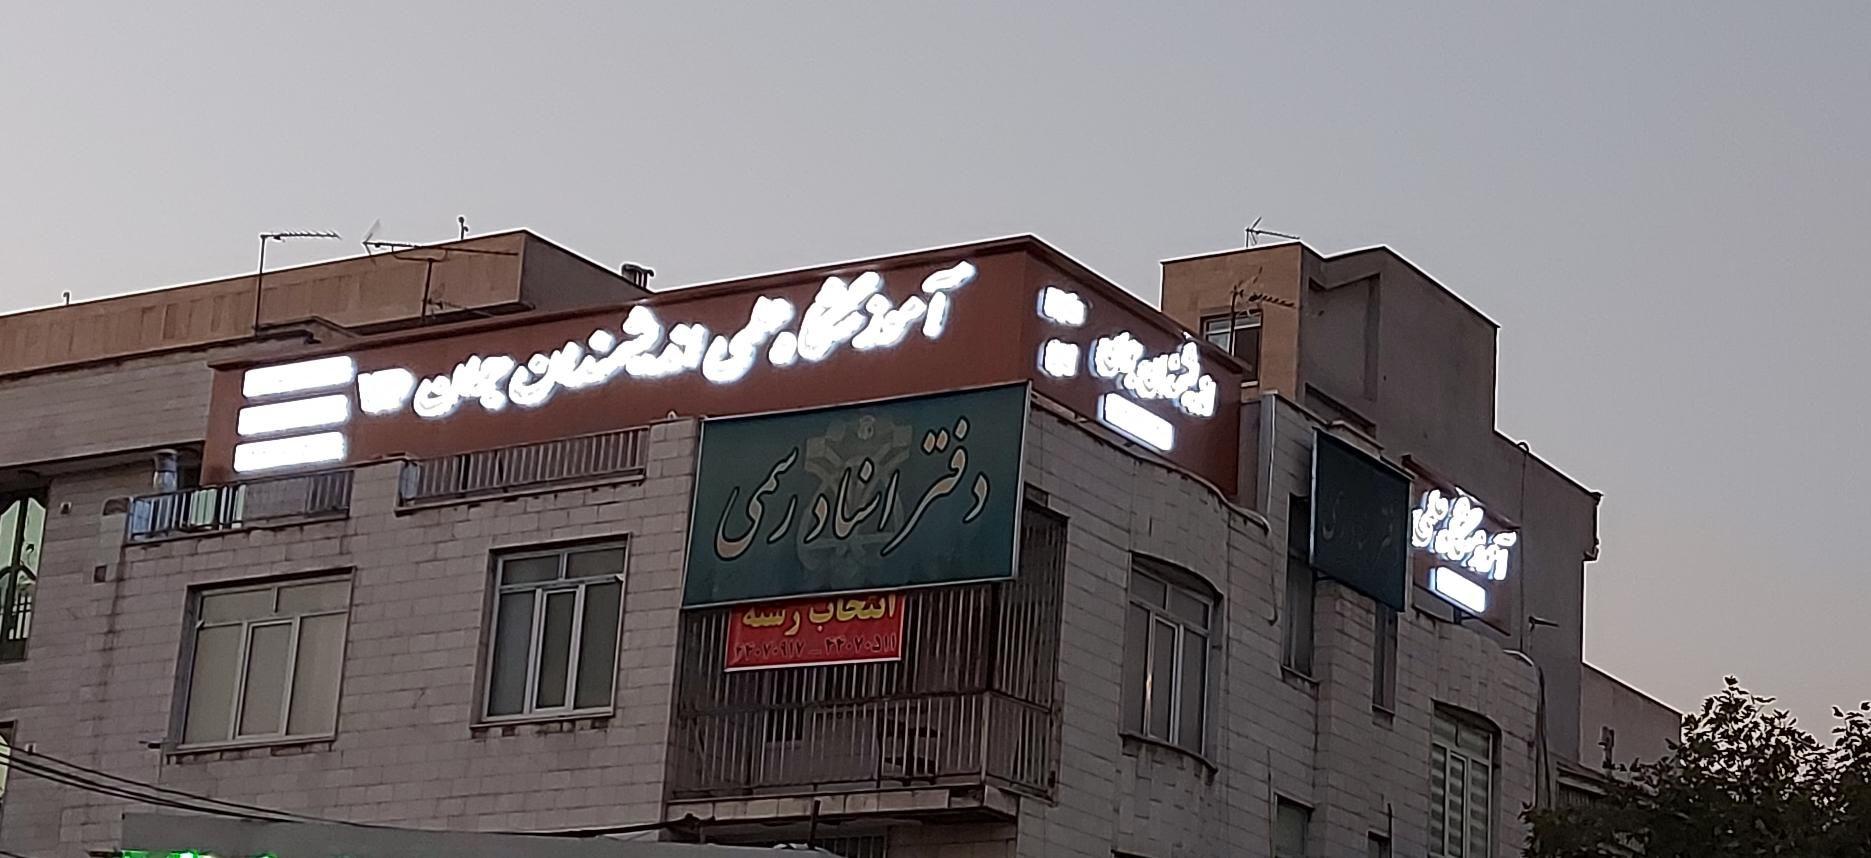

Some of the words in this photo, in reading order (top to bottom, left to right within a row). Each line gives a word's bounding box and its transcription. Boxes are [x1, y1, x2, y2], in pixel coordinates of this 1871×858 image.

[713, 447, 799, 561] رسمی
[803, 457, 900, 544] اسناد
[881, 415, 990, 557] دفتر
